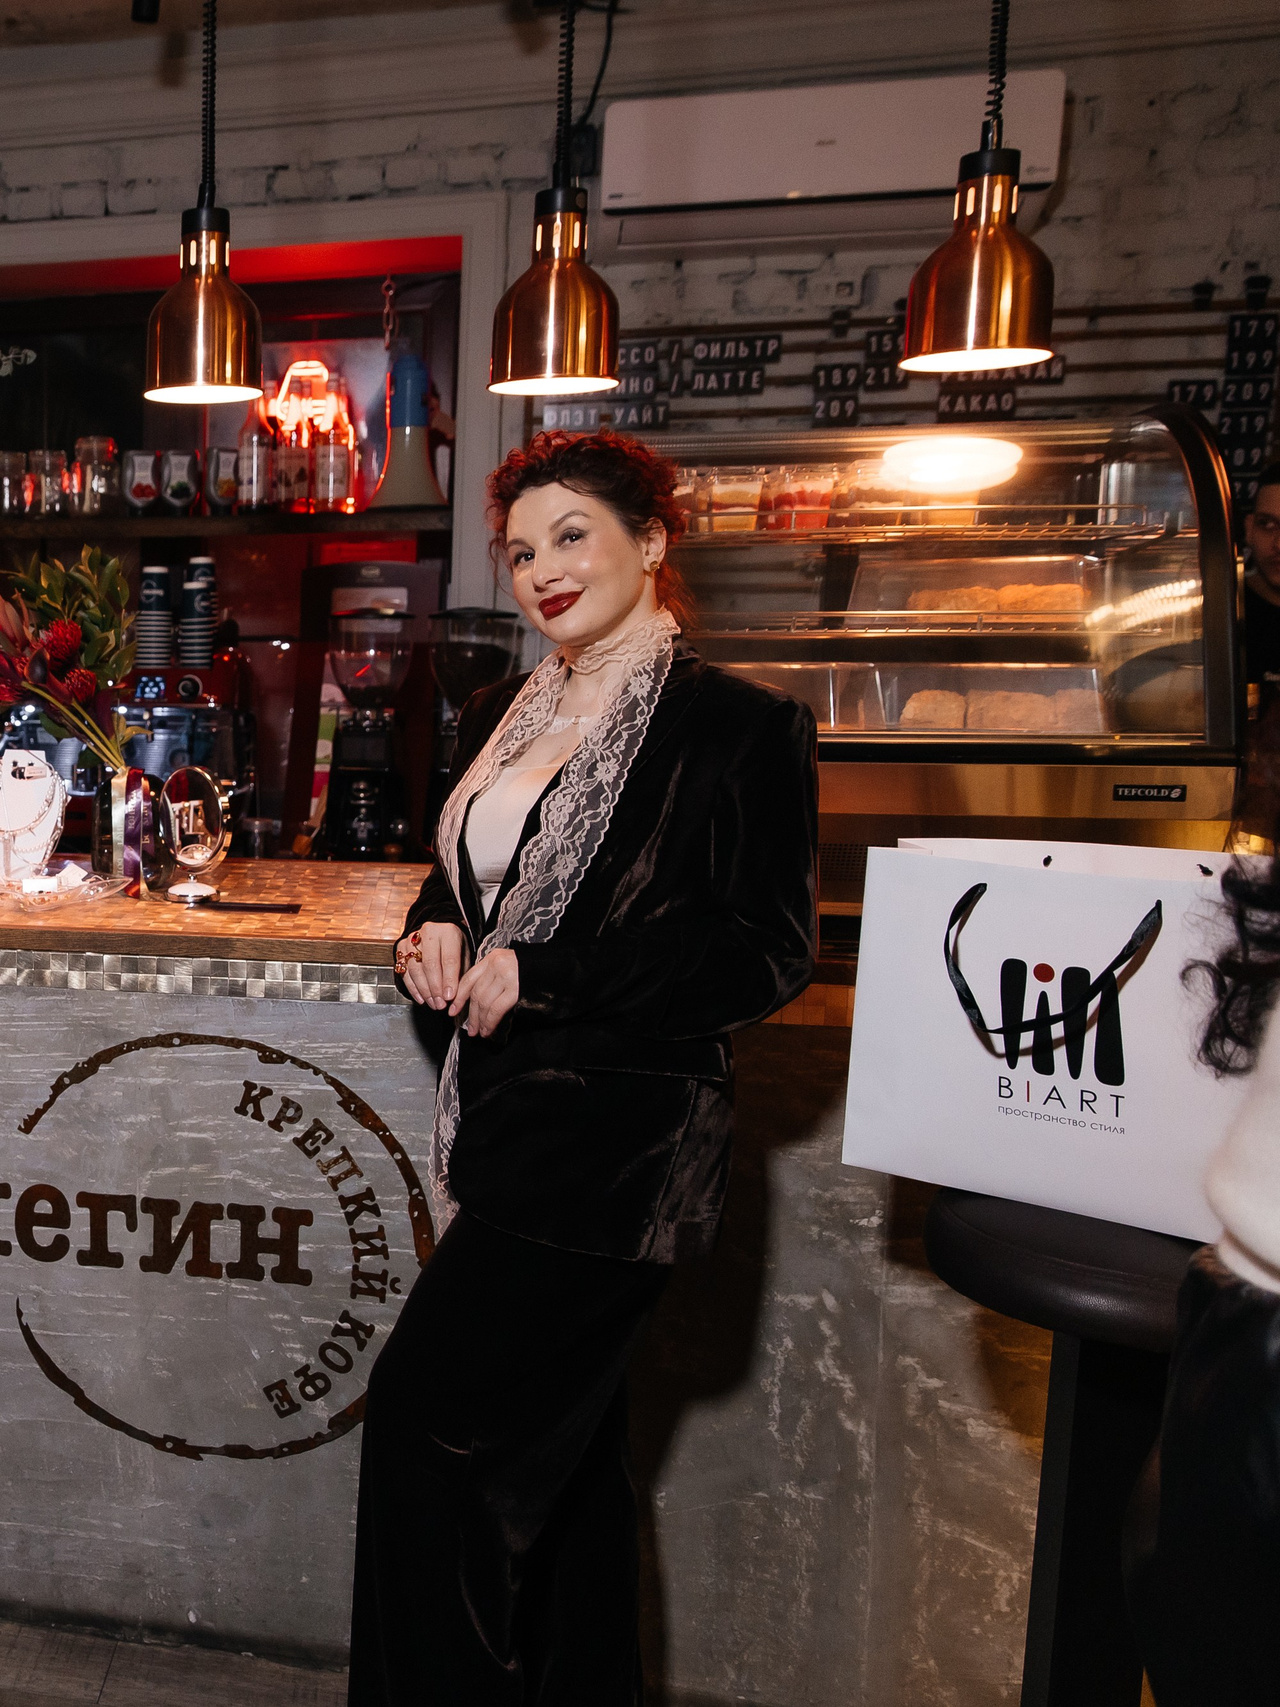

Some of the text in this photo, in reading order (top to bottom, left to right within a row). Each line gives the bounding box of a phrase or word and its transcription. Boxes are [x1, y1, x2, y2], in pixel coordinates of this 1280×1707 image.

[1234, 319, 1275, 338] 179
[693, 338, 779, 360] ФИЛЬТР
[1231, 350, 1273, 369] 199
[692, 370, 762, 391] ЛАТТЕ
[817, 366, 906, 387] 189 219
[938, 392, 1014, 413] КАКАО
[1172, 382, 1270, 402] 179 209
[545, 404, 667, 427] ФЛЭТ УАЙТ
[814, 400, 855, 419] 209
[1221, 415, 1265, 434] 219
[1224, 447, 1261, 466] 09
[1116, 787, 1169, 797] TEFCOLD
[998, 1075, 1125, 1118] BIART
[998, 1105, 1125, 1135] пространство стиля
[233, 1079, 403, 1419] КРЕПКИЙ КОФЕ
